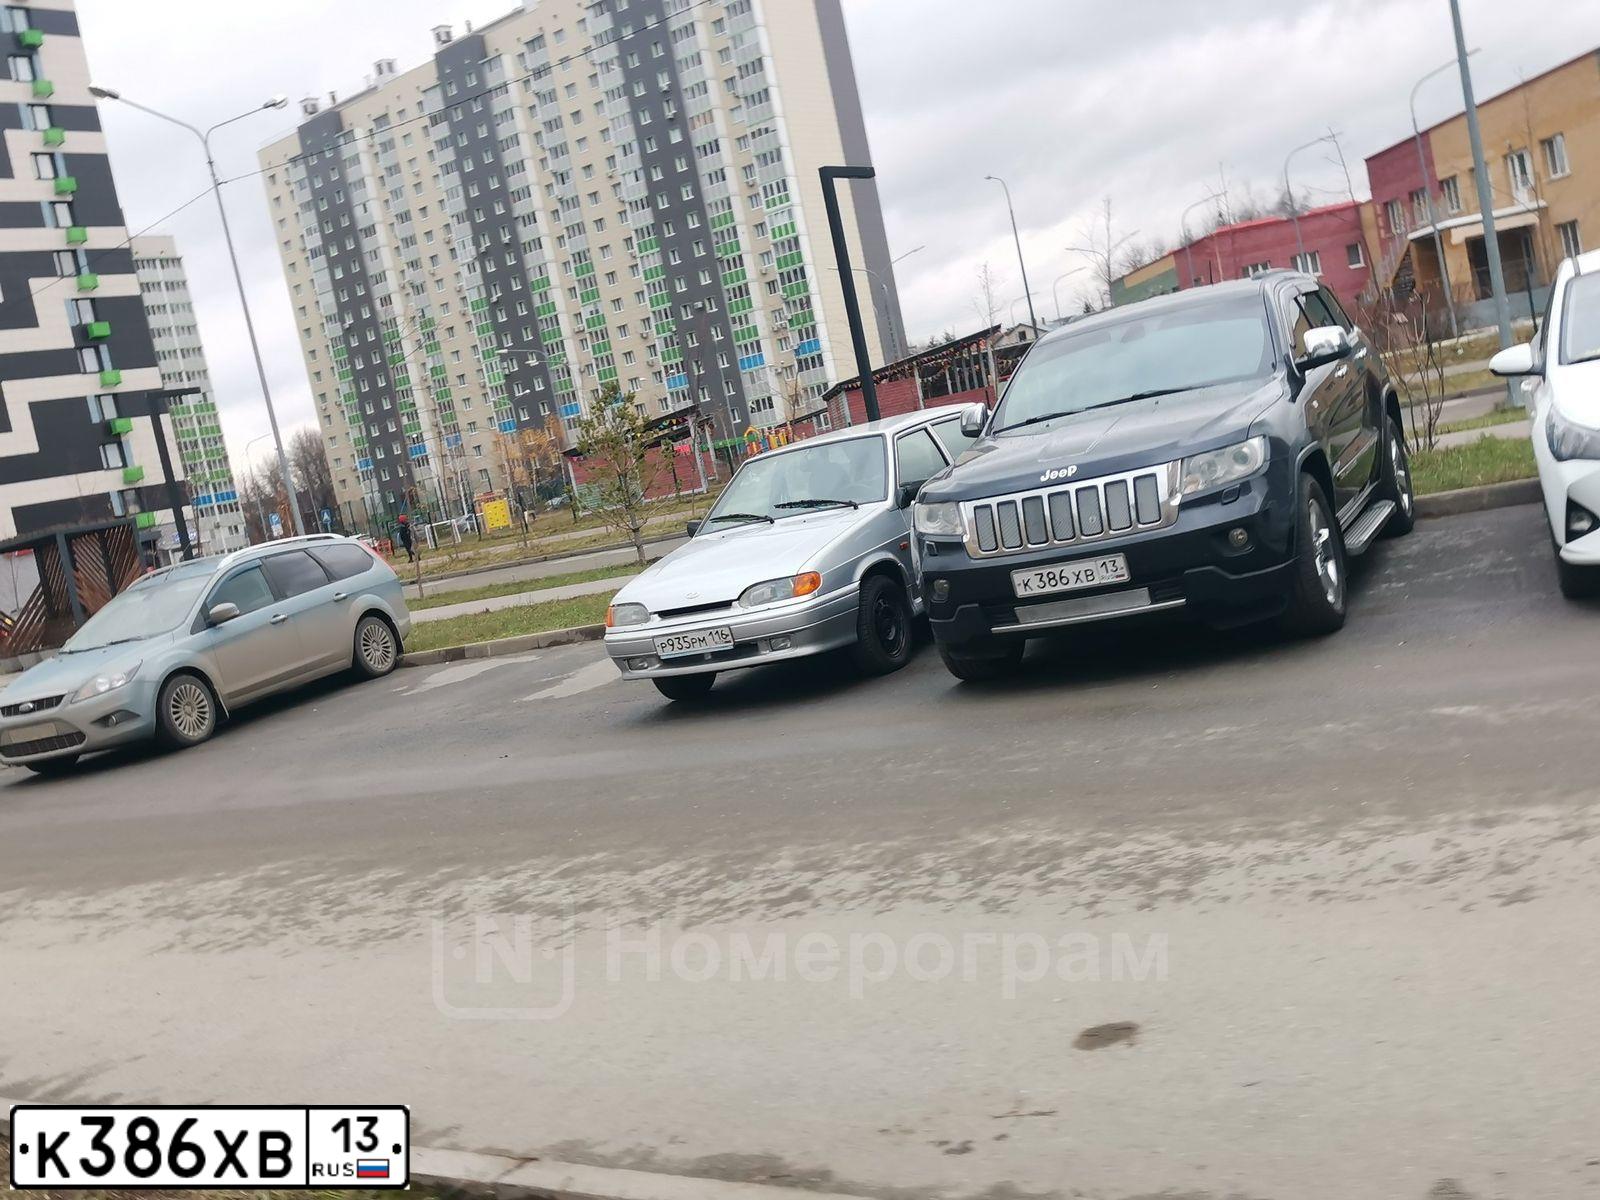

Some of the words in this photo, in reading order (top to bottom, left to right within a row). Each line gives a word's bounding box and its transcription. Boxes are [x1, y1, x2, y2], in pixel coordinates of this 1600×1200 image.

[1040, 464, 1077, 482] Jeep
[1022, 569, 1095, 592] К386ХВ
[1100, 560, 1119, 574] 13
[660, 635, 708, 653] Р935РМ
[708, 629, 729, 642] 116
